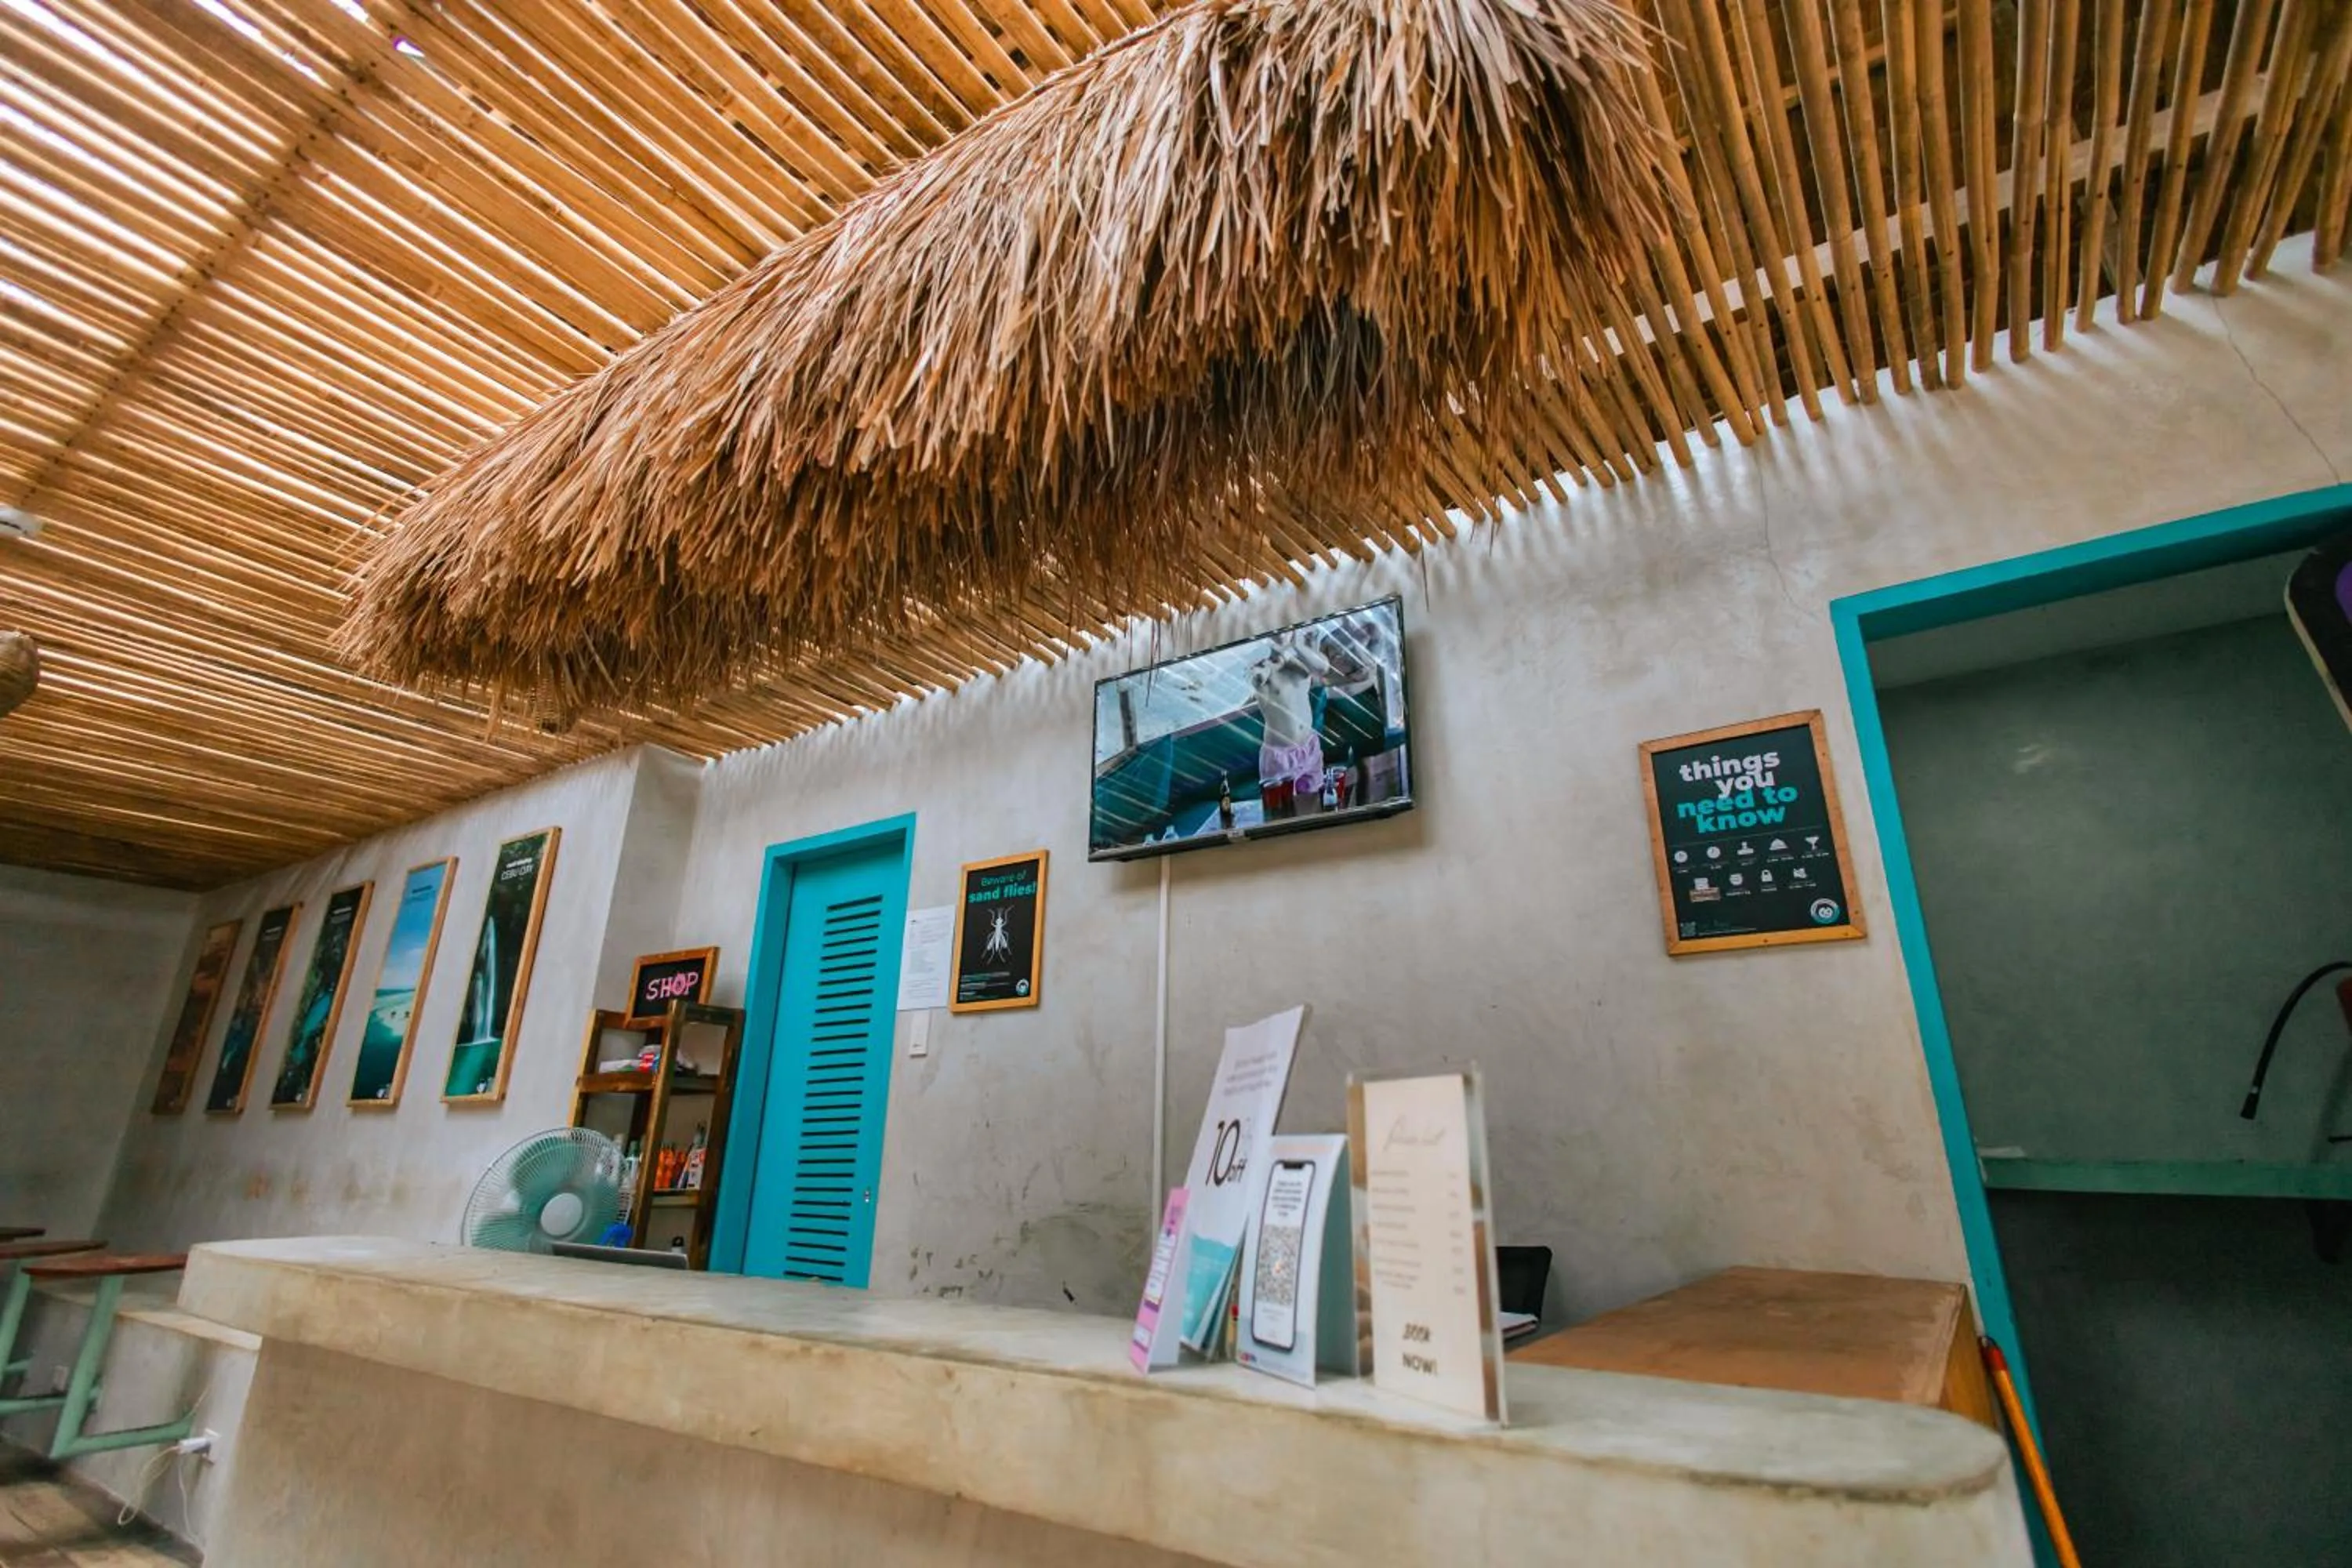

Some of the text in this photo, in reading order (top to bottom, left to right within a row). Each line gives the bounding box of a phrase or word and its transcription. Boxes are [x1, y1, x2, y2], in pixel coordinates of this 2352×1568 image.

[1679, 752, 1780, 782] things
[1715, 771, 1776, 799] you
[1677, 786, 1798, 818] need to
[1696, 806, 1786, 833] know
[967, 886, 1001, 903] sand
[645, 971, 699, 1000] SHOP
[1205, 1118, 1241, 1188] 10
